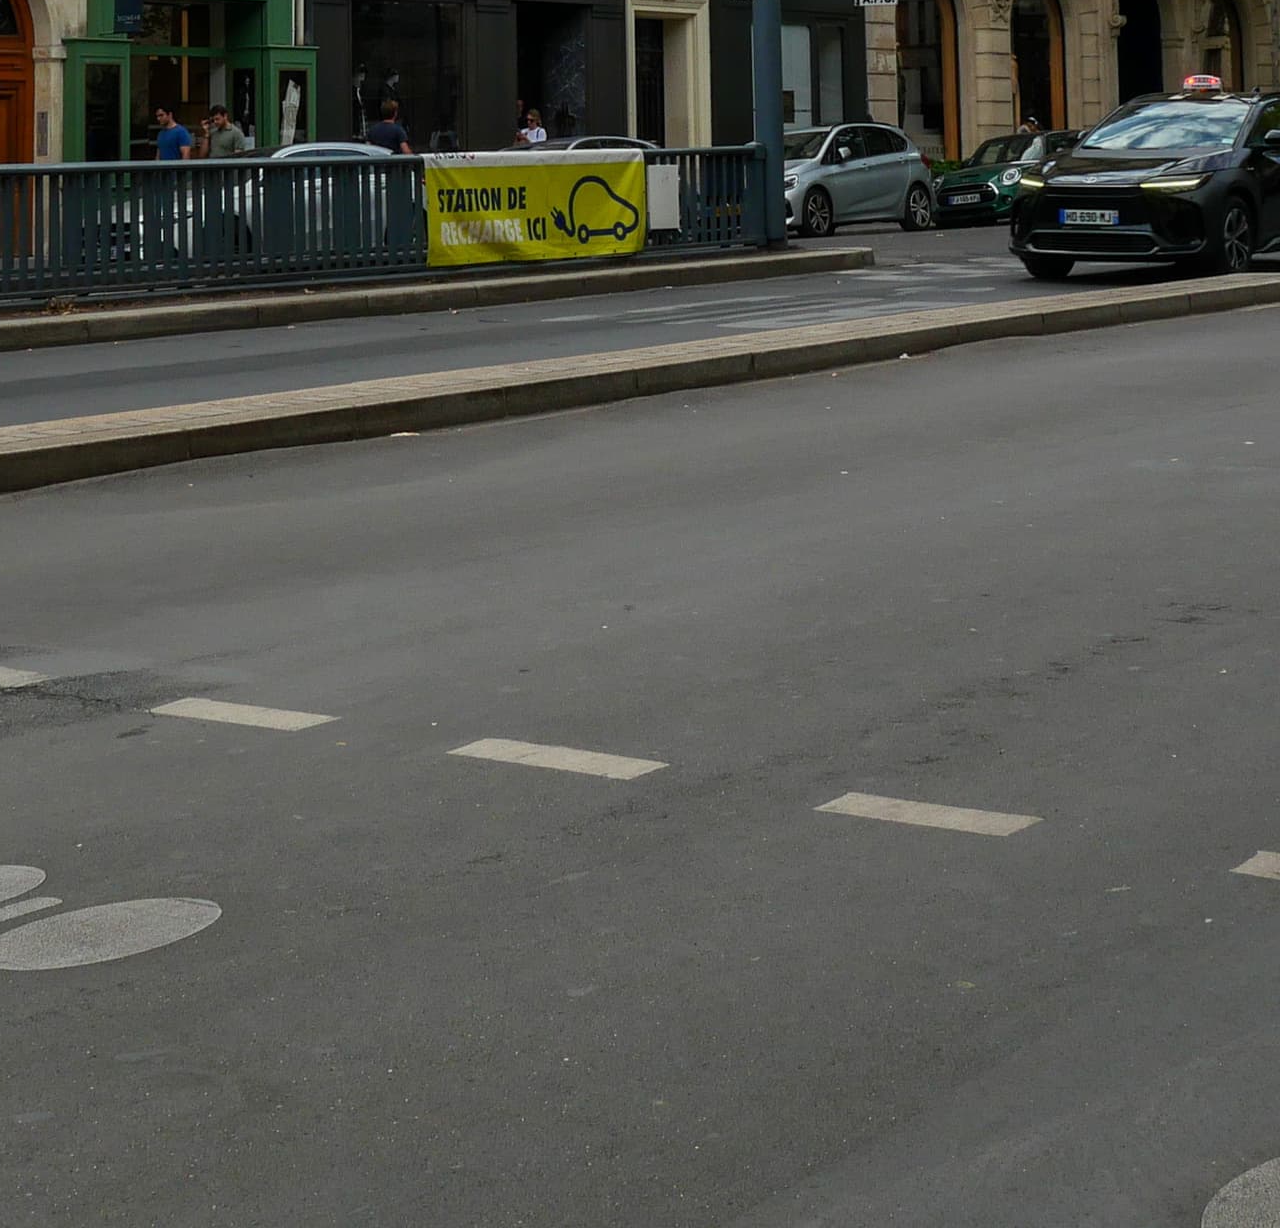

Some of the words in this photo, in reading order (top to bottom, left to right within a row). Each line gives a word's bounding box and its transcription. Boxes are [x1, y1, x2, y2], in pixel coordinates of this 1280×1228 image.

[437, 188, 502, 213] STATION
[508, 186, 527, 210] DE
[441, 218, 524, 245] RECHARGE
[527, 217, 547, 240] ICI
